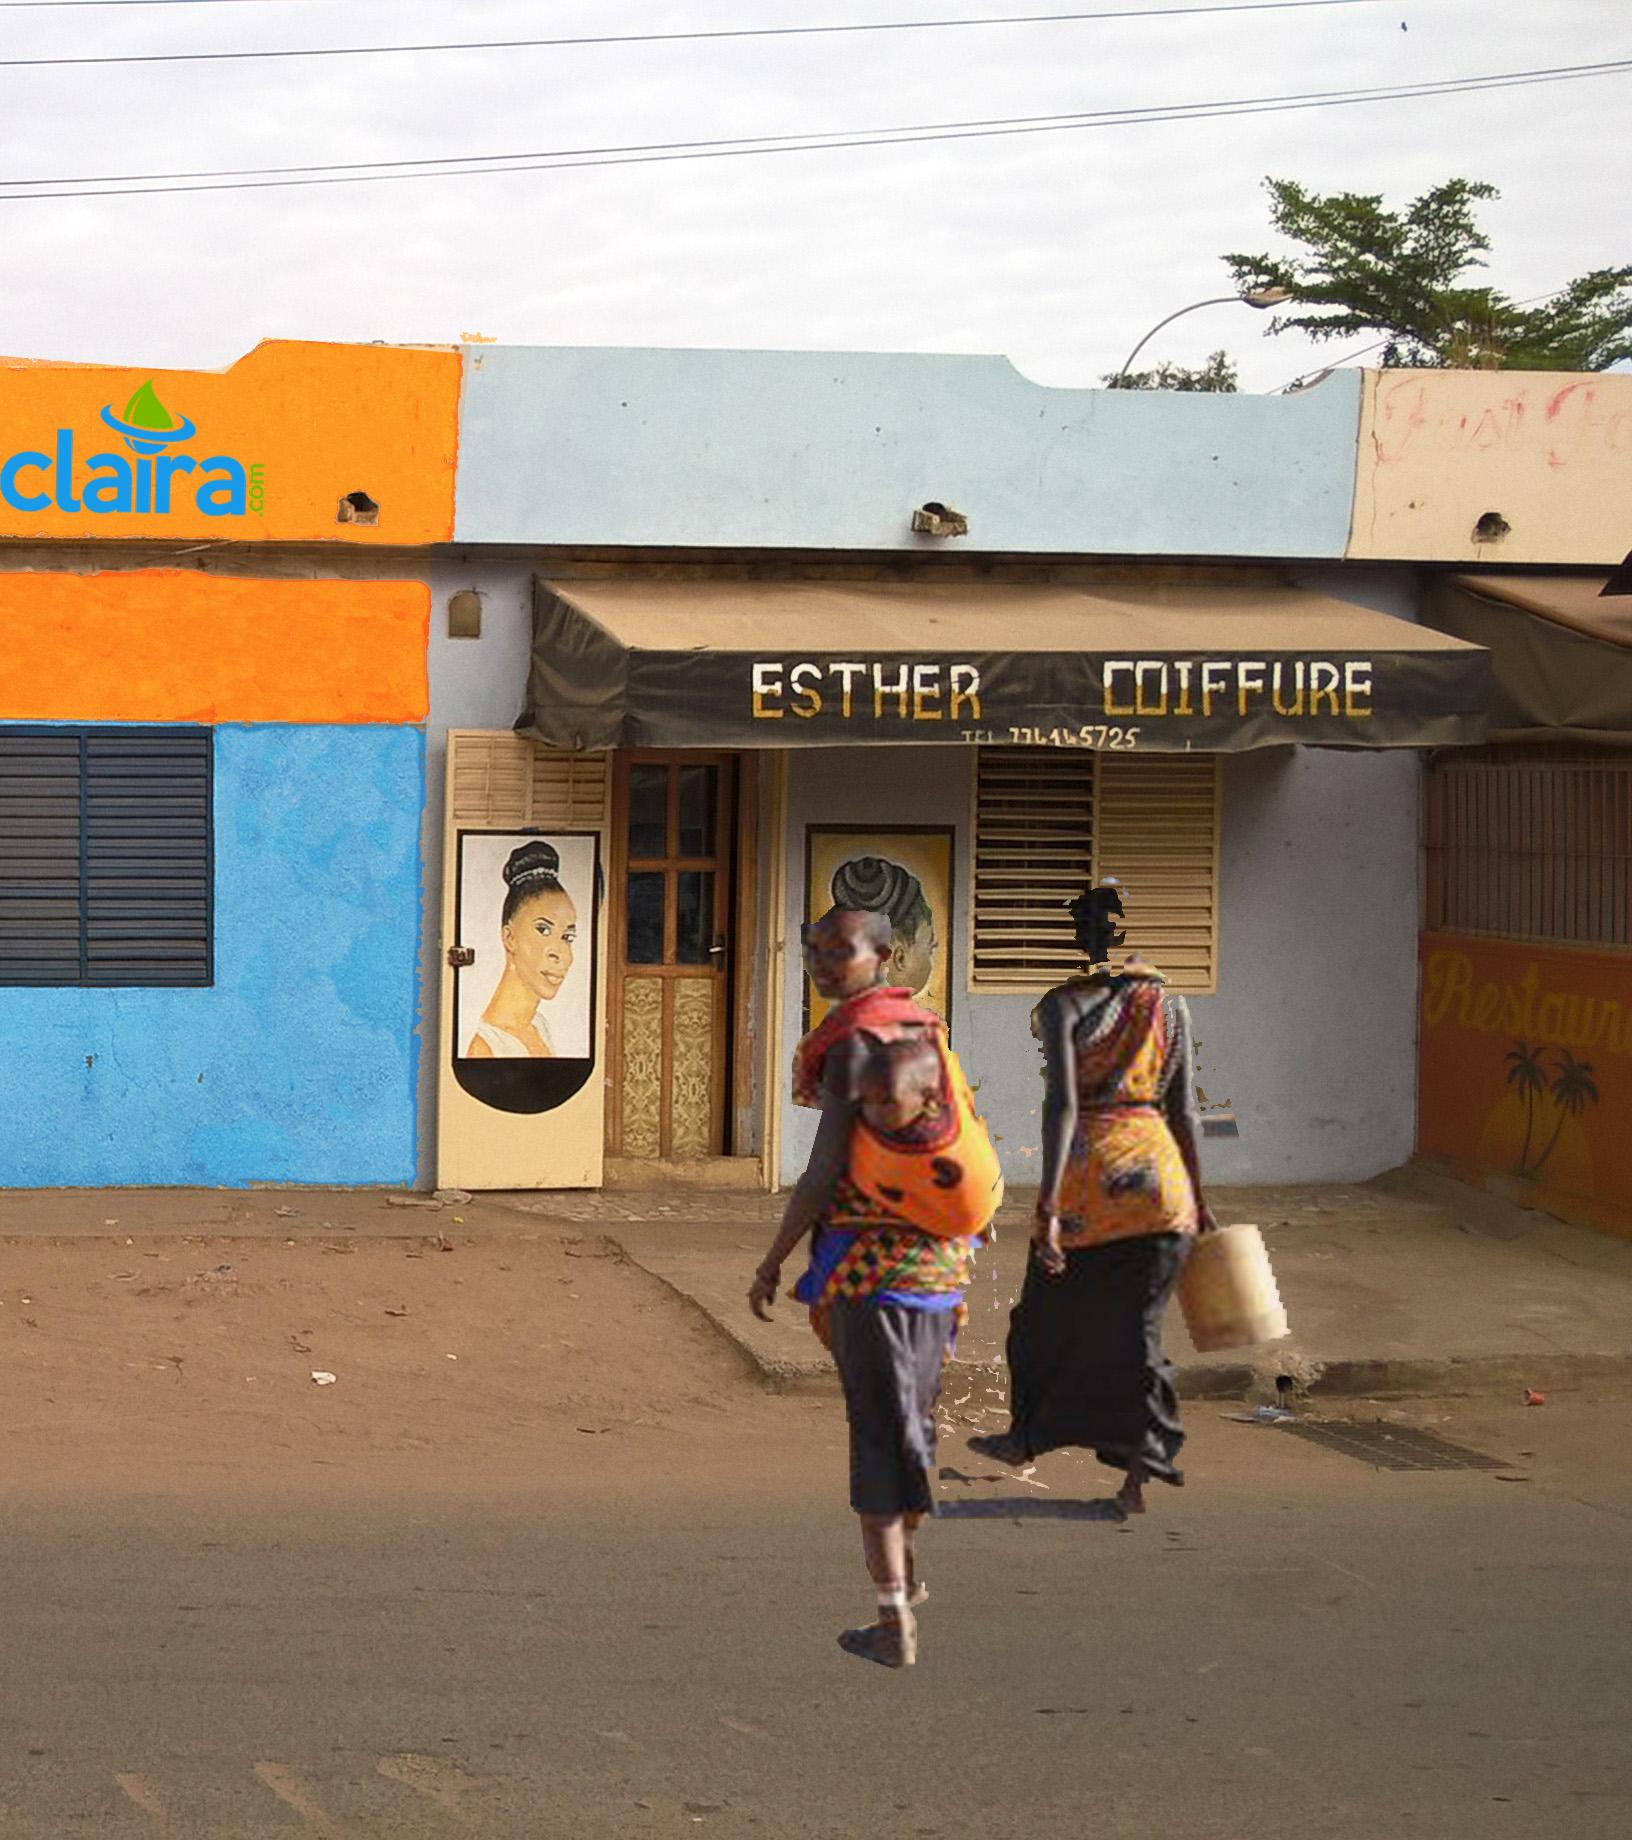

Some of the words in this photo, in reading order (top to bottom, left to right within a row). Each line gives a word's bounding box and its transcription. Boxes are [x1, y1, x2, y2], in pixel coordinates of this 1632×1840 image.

[249, 463, 265, 519] .com
[752, 662, 981, 721] ESTHER
[1103, 660, 1373, 717] COIFFURE
